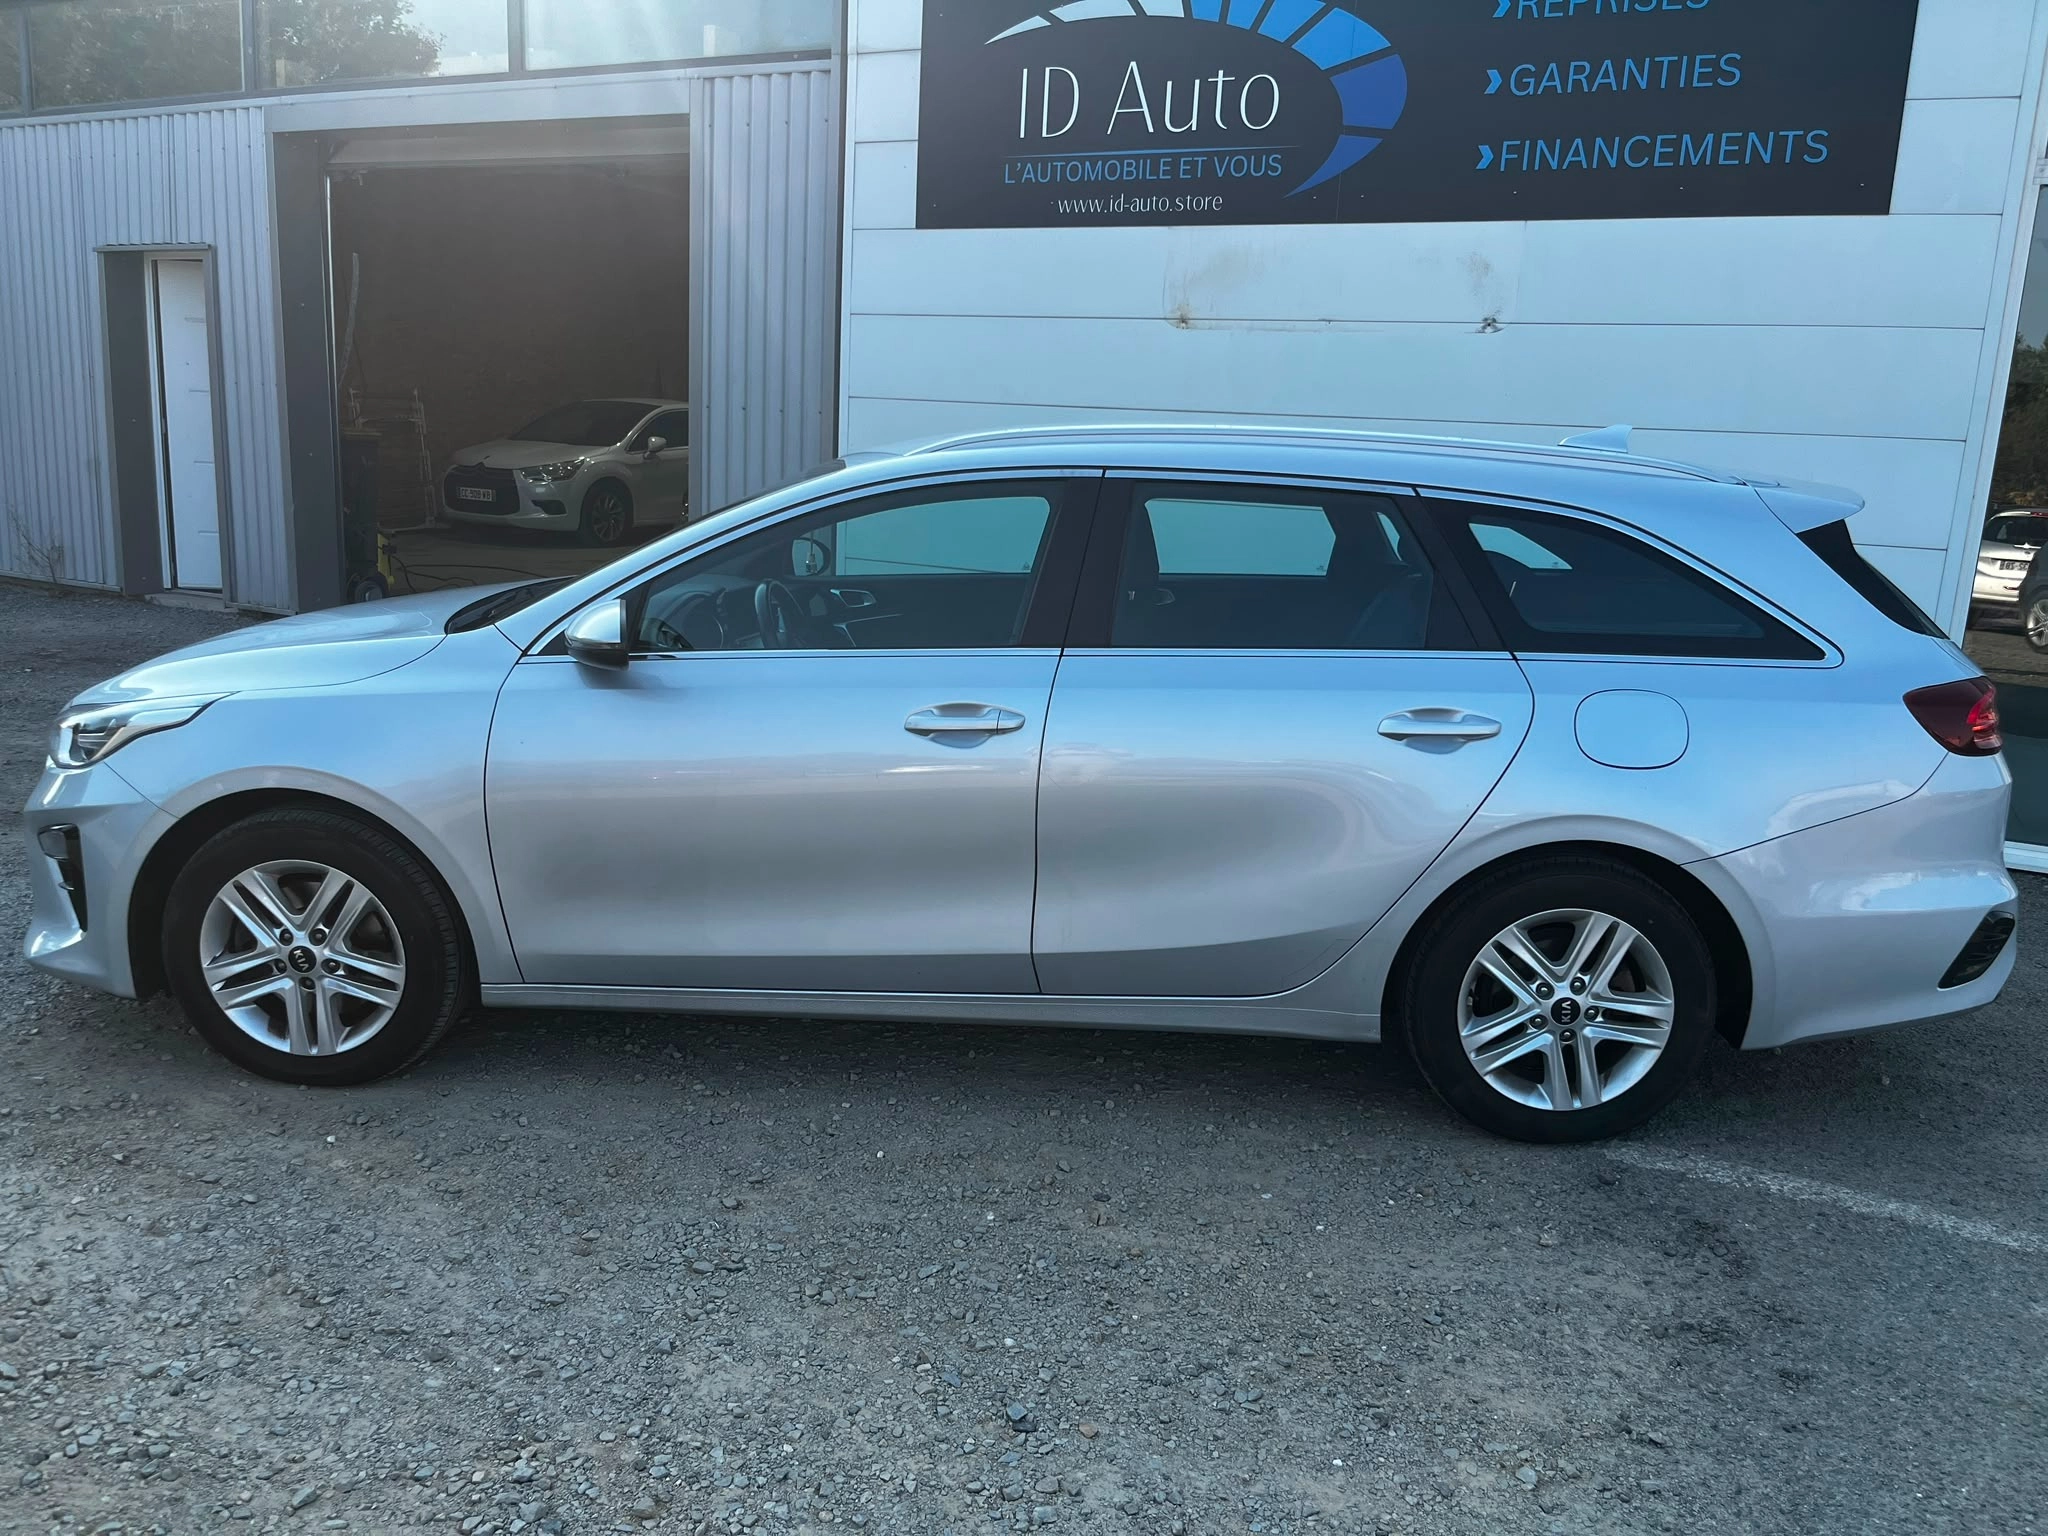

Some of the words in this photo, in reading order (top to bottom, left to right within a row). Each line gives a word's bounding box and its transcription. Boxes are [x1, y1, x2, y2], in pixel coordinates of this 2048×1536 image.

[1509, 52, 1742, 96] GARANTIES
[1019, 66, 1080, 139] ID
[1107, 61, 1281, 136] Auto
[1499, 129, 1829, 172] FINANCEMENTS
[1004, 157, 1172, 184] L'AUTOMOBILE
[1179, 157, 1207, 179] ET
[1214, 154, 1282, 178] VOUS
[1058, 193, 1223, 214] www.id-auto.store
[293, 949, 309, 971] KIA
[1561, 1000, 1571, 1023] KIA
